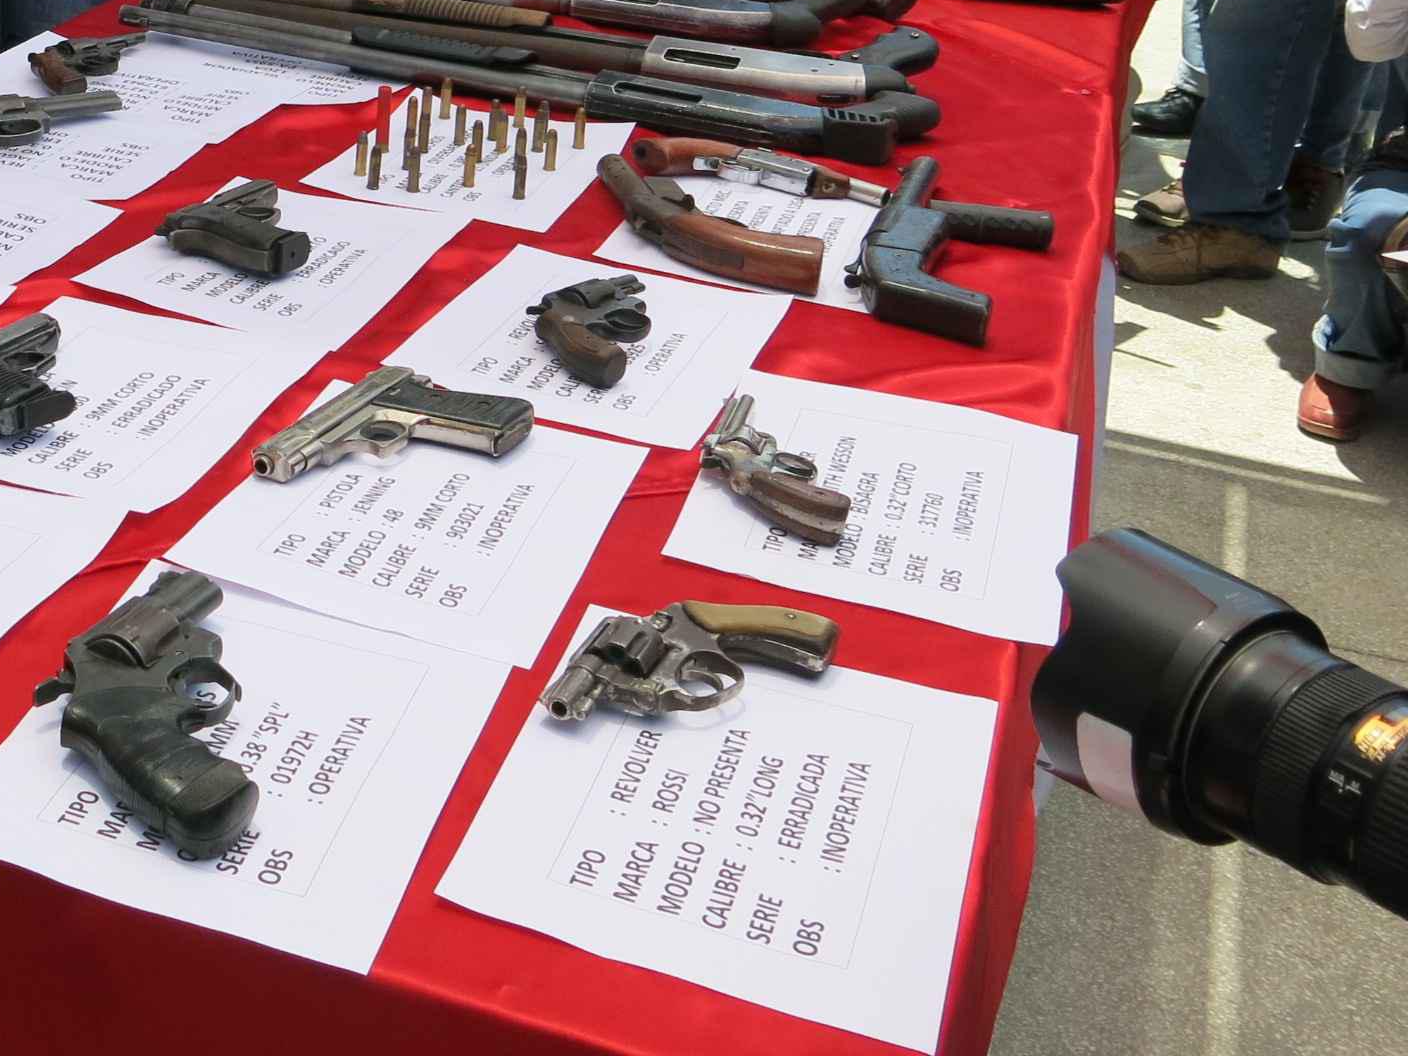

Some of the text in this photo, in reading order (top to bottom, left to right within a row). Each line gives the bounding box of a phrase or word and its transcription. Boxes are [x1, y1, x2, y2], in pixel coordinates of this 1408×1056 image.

[14, 212, 47, 224] OBS
[156, 272, 185, 285] TIPO
[181, 271, 221, 291] MARCA
[206, 272, 251, 296] MODELO
[230, 278, 273, 303] CALIBRE
[252, 293, 284, 311] SERIE
[277, 302, 303, 316] OBS
[471, 356, 498, 374] TIPO
[499, 356, 536, 383] MARCA
[612, 393, 636, 410] OBS
[644, 333, 685, 371] OPERATIVA
[28, 430, 79, 463] CALIBRE
[85, 398, 120, 421] 9MM
[113, 372, 154, 398] CORTO
[54, 448, 93, 471] SERIE
[111, 375, 181, 428] ERRADICADO
[82, 379, 208, 479] OBS INOPERATIVA
[830, 436, 857, 472] WESSON
[273, 474, 362, 555] TIPO PISTOLA
[306, 476, 395, 567] MARCA JENNING
[338, 508, 404, 577] MODELO 48
[372, 473, 470, 587] CALIBRE 9MM CORTO
[404, 502, 484, 599] SERIE 903021
[438, 484, 534, 608] OBS INOPERATIVA
[762, 525, 790, 550] TIPO
[832, 472, 880, 567] MODELO BISAGRA
[868, 534, 896, 575] CALIBRE
[903, 492, 944, 584] SERIE 317760
[939, 471, 983, 592] OBS INOPERATIVA
[57, 790, 103, 825] TIPO
[216, 730, 317, 875] SERIE 01972H
[257, 717, 370, 885] OBS OPERATIVA
[569, 729, 662, 886] TIPO REVOLVER
[613, 769, 688, 902] MARCA ROSSI
[657, 729, 749, 915] MODELO NO PRESENTA
[746, 754, 828, 944] SERIE ERRADICADA
[792, 762, 869, 956] OBS INOPERATIVA
[702, 859, 746, 929] CALIBRE
